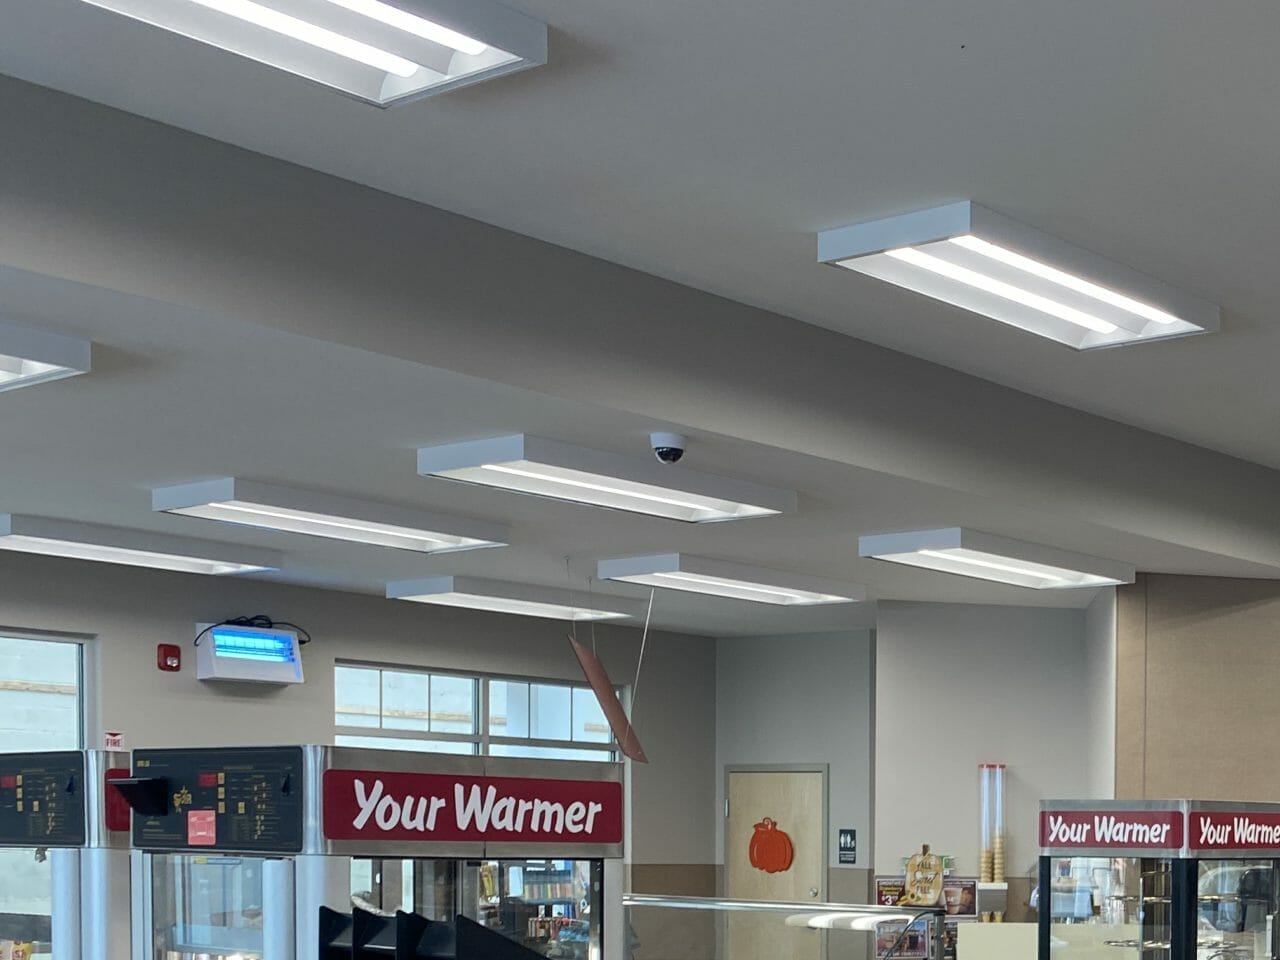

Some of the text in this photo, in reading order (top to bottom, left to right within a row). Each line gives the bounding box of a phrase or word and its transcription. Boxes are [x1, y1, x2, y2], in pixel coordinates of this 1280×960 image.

[106, 738, 122, 748] FIRE
[353, 779, 602, 834] Your Warmer
[1048, 816, 1170, 844] Your Warmer
[1199, 817, 1231, 845] Your
